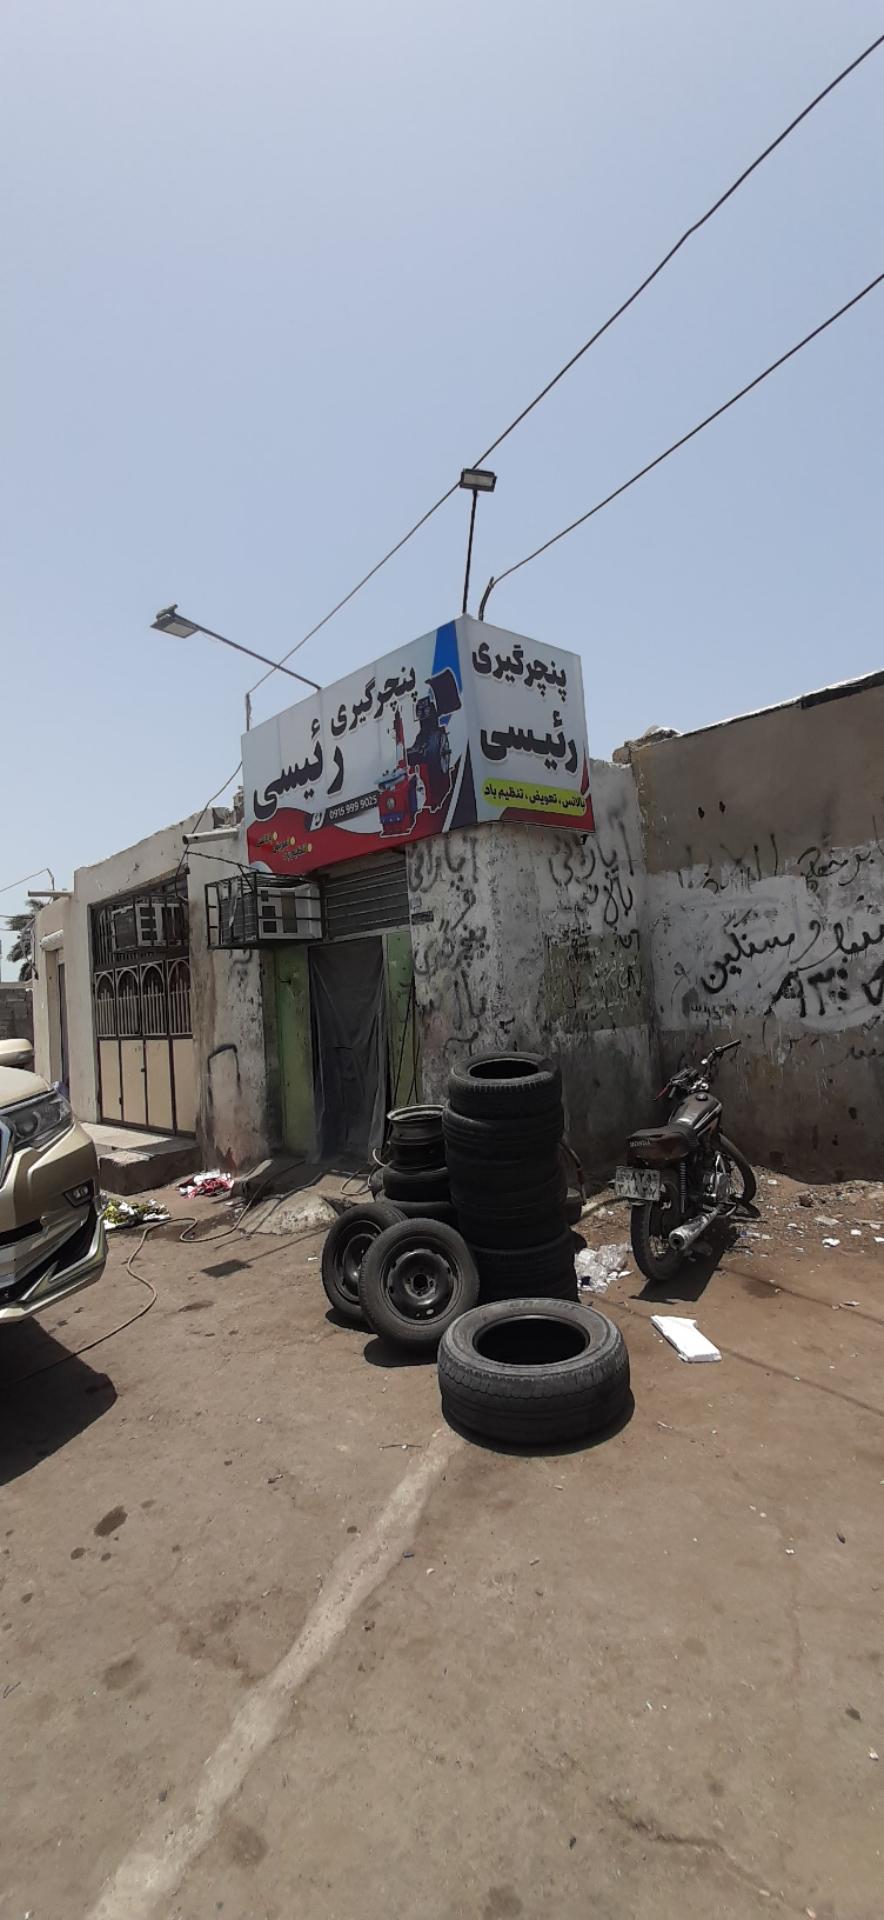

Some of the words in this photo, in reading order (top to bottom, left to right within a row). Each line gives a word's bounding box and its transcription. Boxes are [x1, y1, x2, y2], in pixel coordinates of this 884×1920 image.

[331, 666, 418, 736] پنچرگیری
[472, 642, 567, 702] پنچرگیری
[254, 718, 344, 819] رئیسی
[481, 710, 578, 773] رئیسی
[329, 806, 345, 819] 0915
[346, 801, 359, 813] 999
[360, 795, 377, 808] 9025
[484, 784, 497, 798] باد
[498, 786, 524, 800] تنظیم
